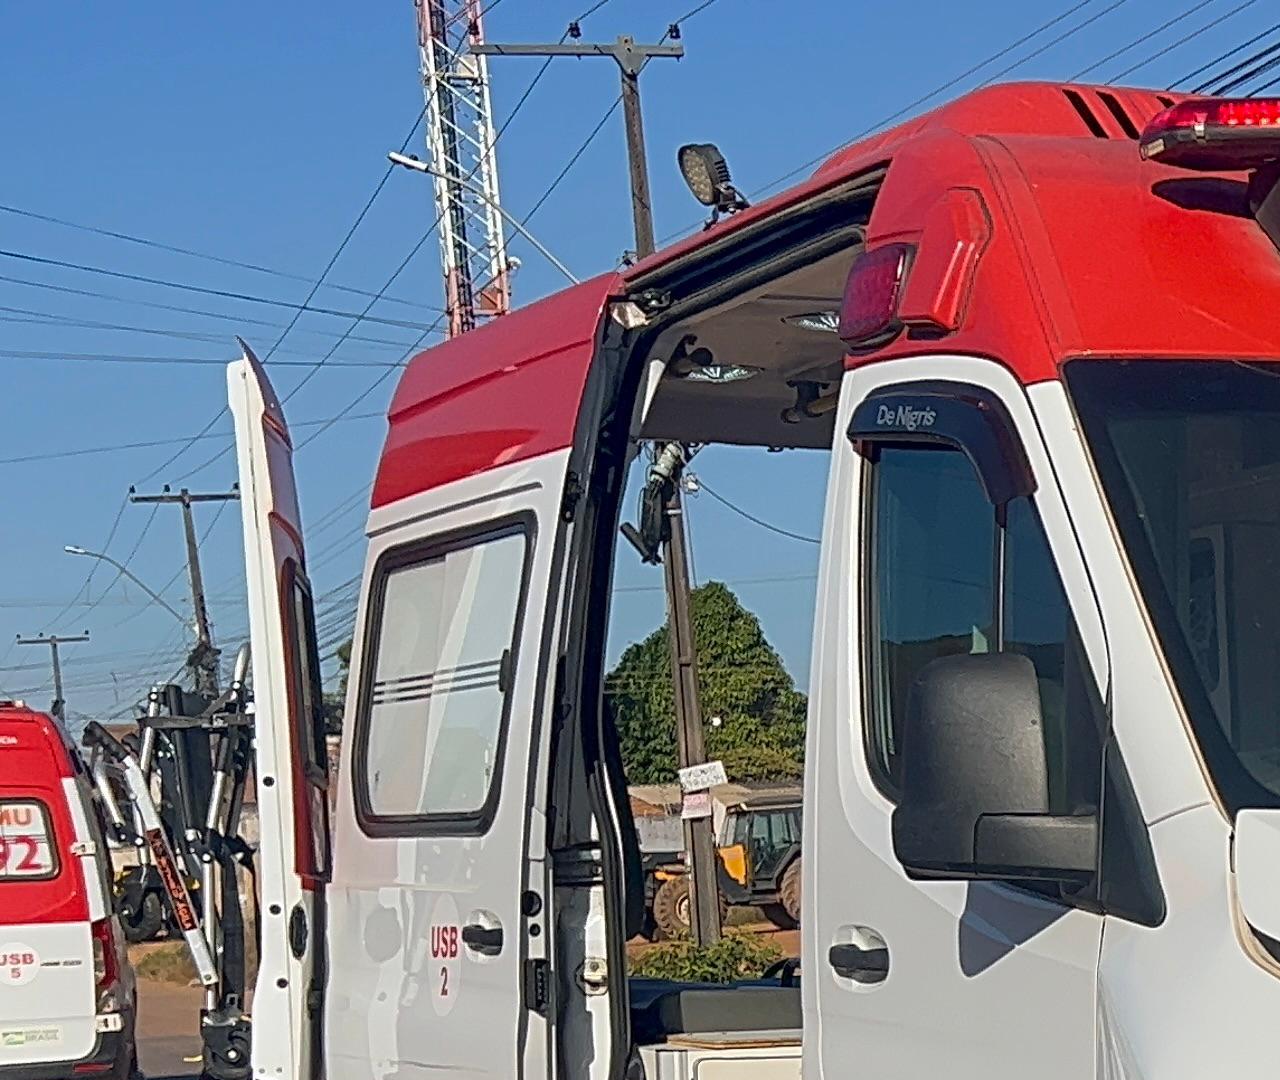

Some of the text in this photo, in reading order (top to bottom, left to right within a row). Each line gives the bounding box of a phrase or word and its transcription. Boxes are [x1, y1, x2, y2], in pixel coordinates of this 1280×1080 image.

[877, 405, 937, 431] De Nigris
[430, 926, 458, 958] USB
[10, 967, 21, 979] 5
[440, 966, 448, 996] 2
